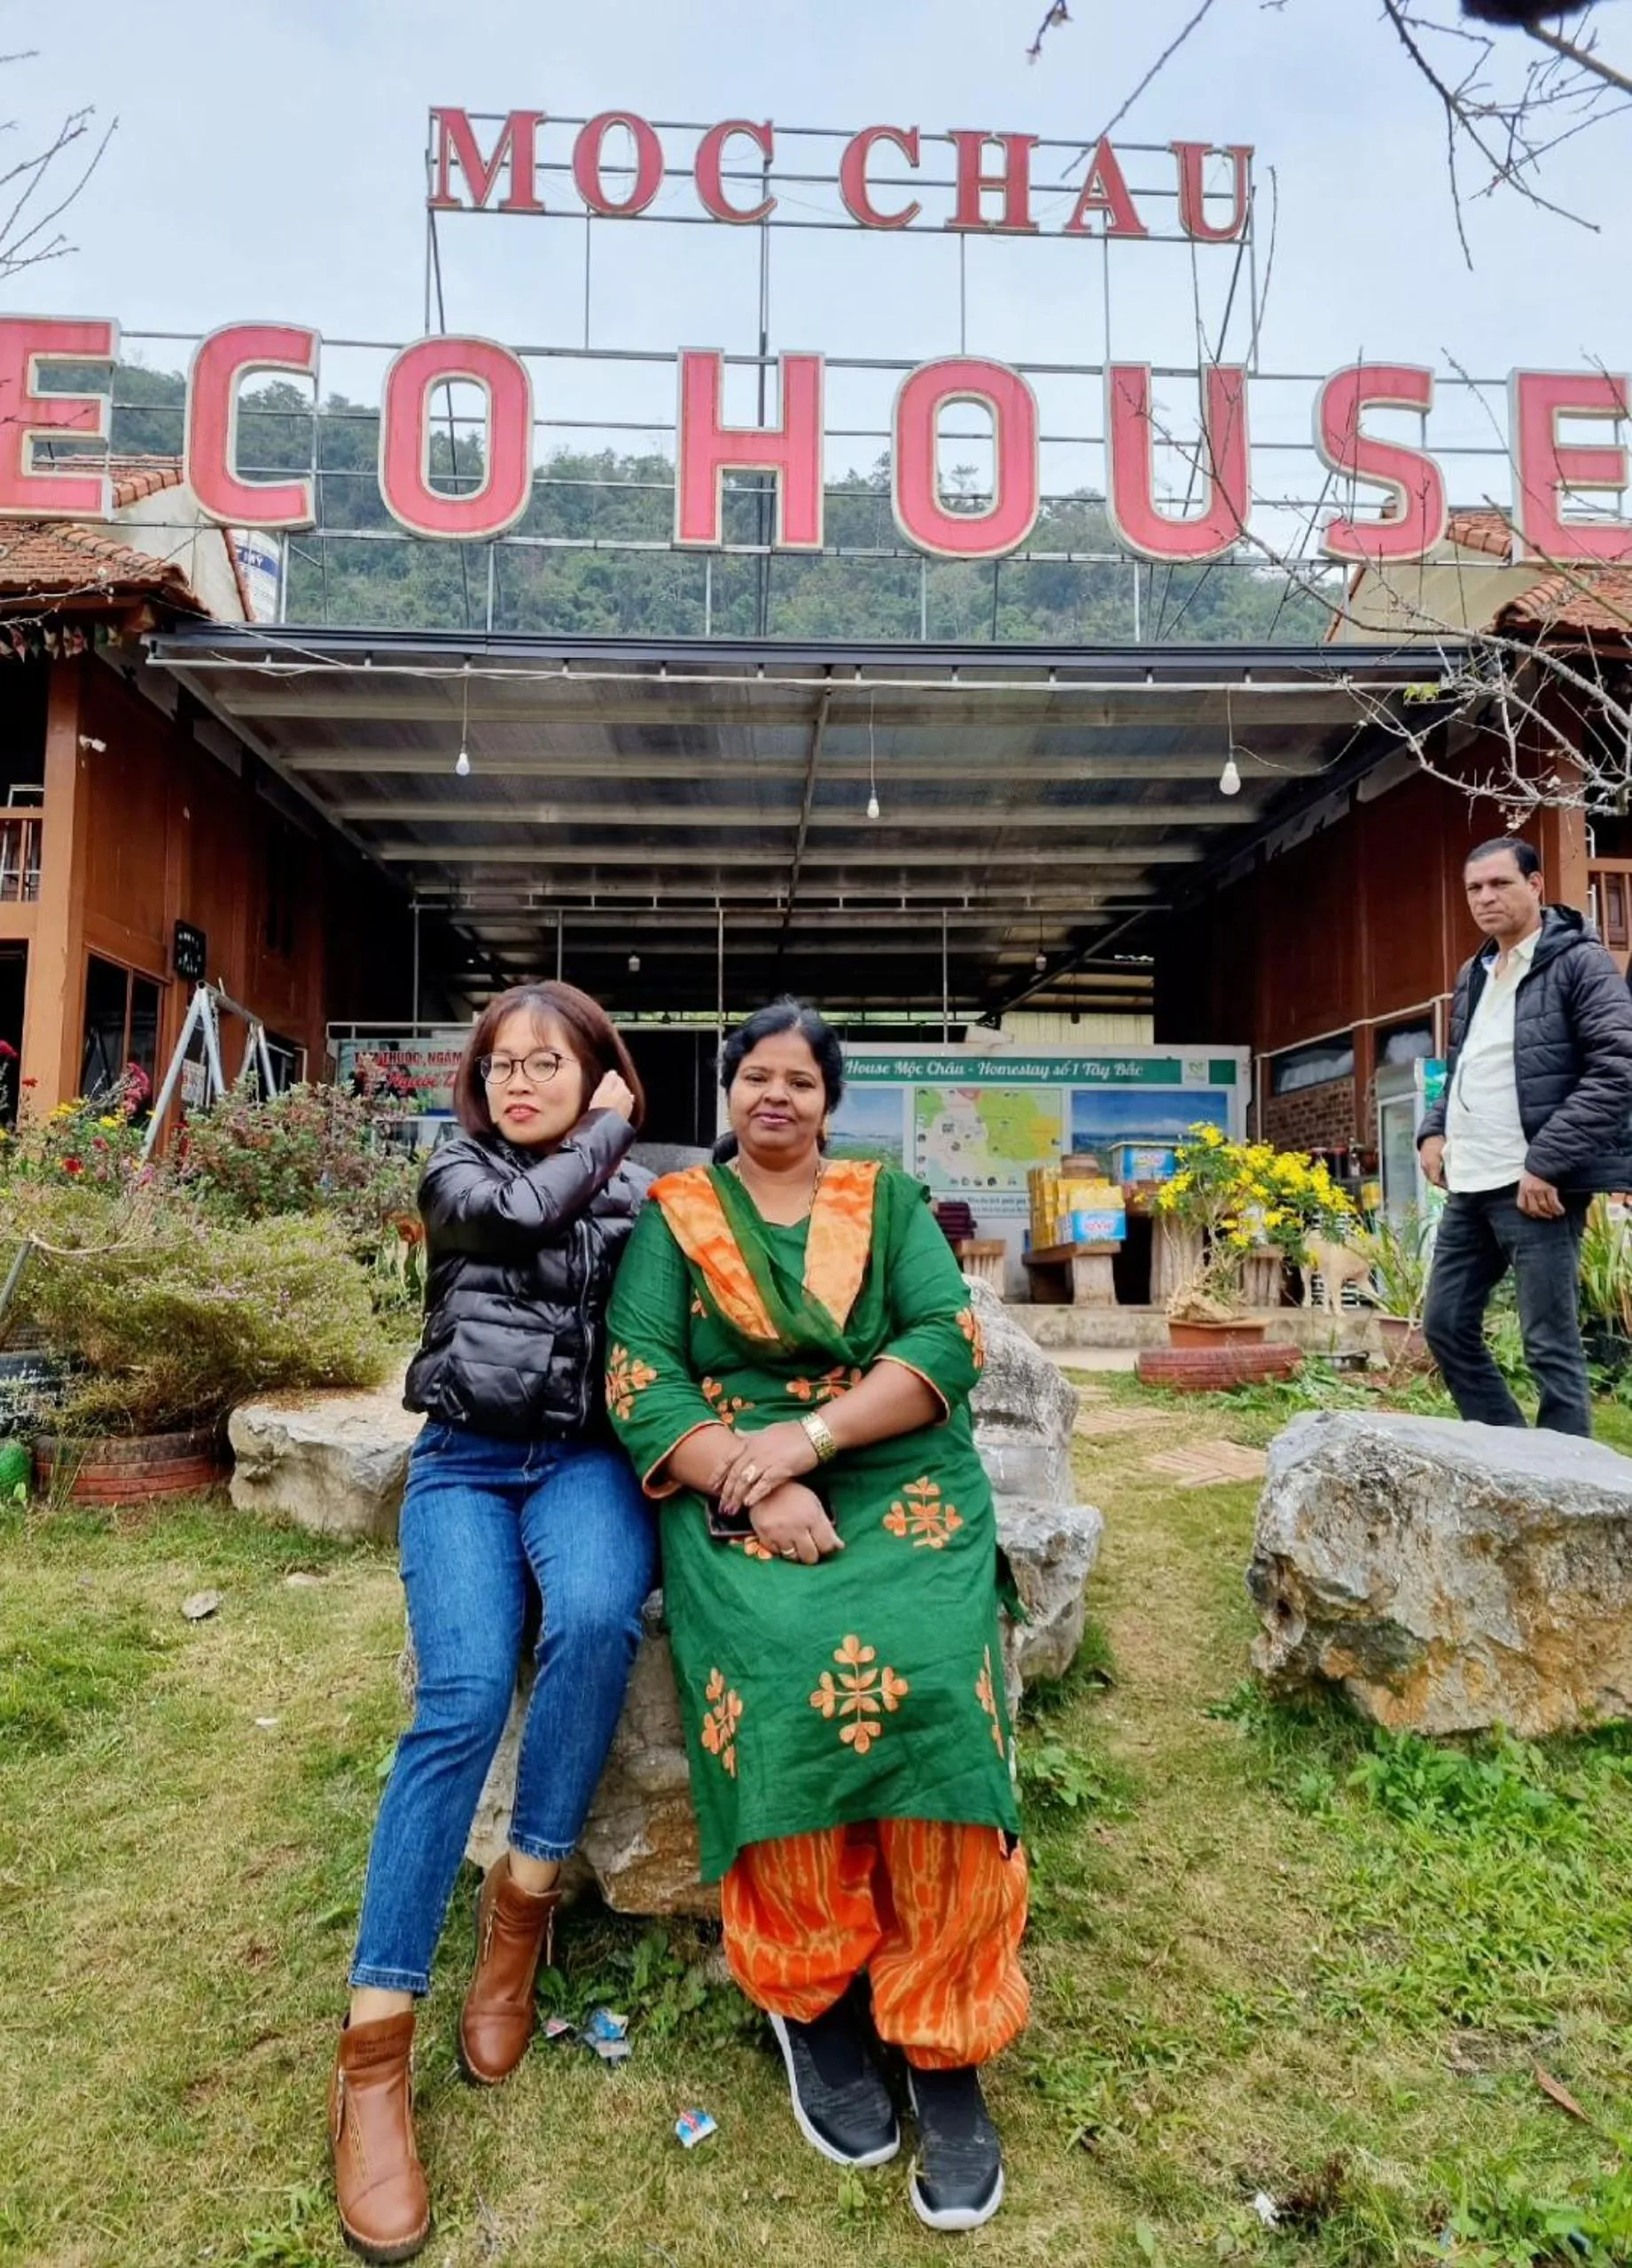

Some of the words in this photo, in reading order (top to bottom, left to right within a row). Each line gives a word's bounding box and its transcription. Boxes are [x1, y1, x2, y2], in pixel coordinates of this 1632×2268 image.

[427, 105, 777, 225] MOC
[839, 123, 1255, 244] CHAU
[0, 316, 534, 542] ECO
[671, 347, 1632, 564] HOUSE
[845, 1059, 890, 1075] House
[894, 1061, 925, 1078] Mộc
[926, 1061, 965, 1075] Châu
[978, 1062, 1049, 1079] Homestay
[1081, 1062, 1112, 1079] Tây
